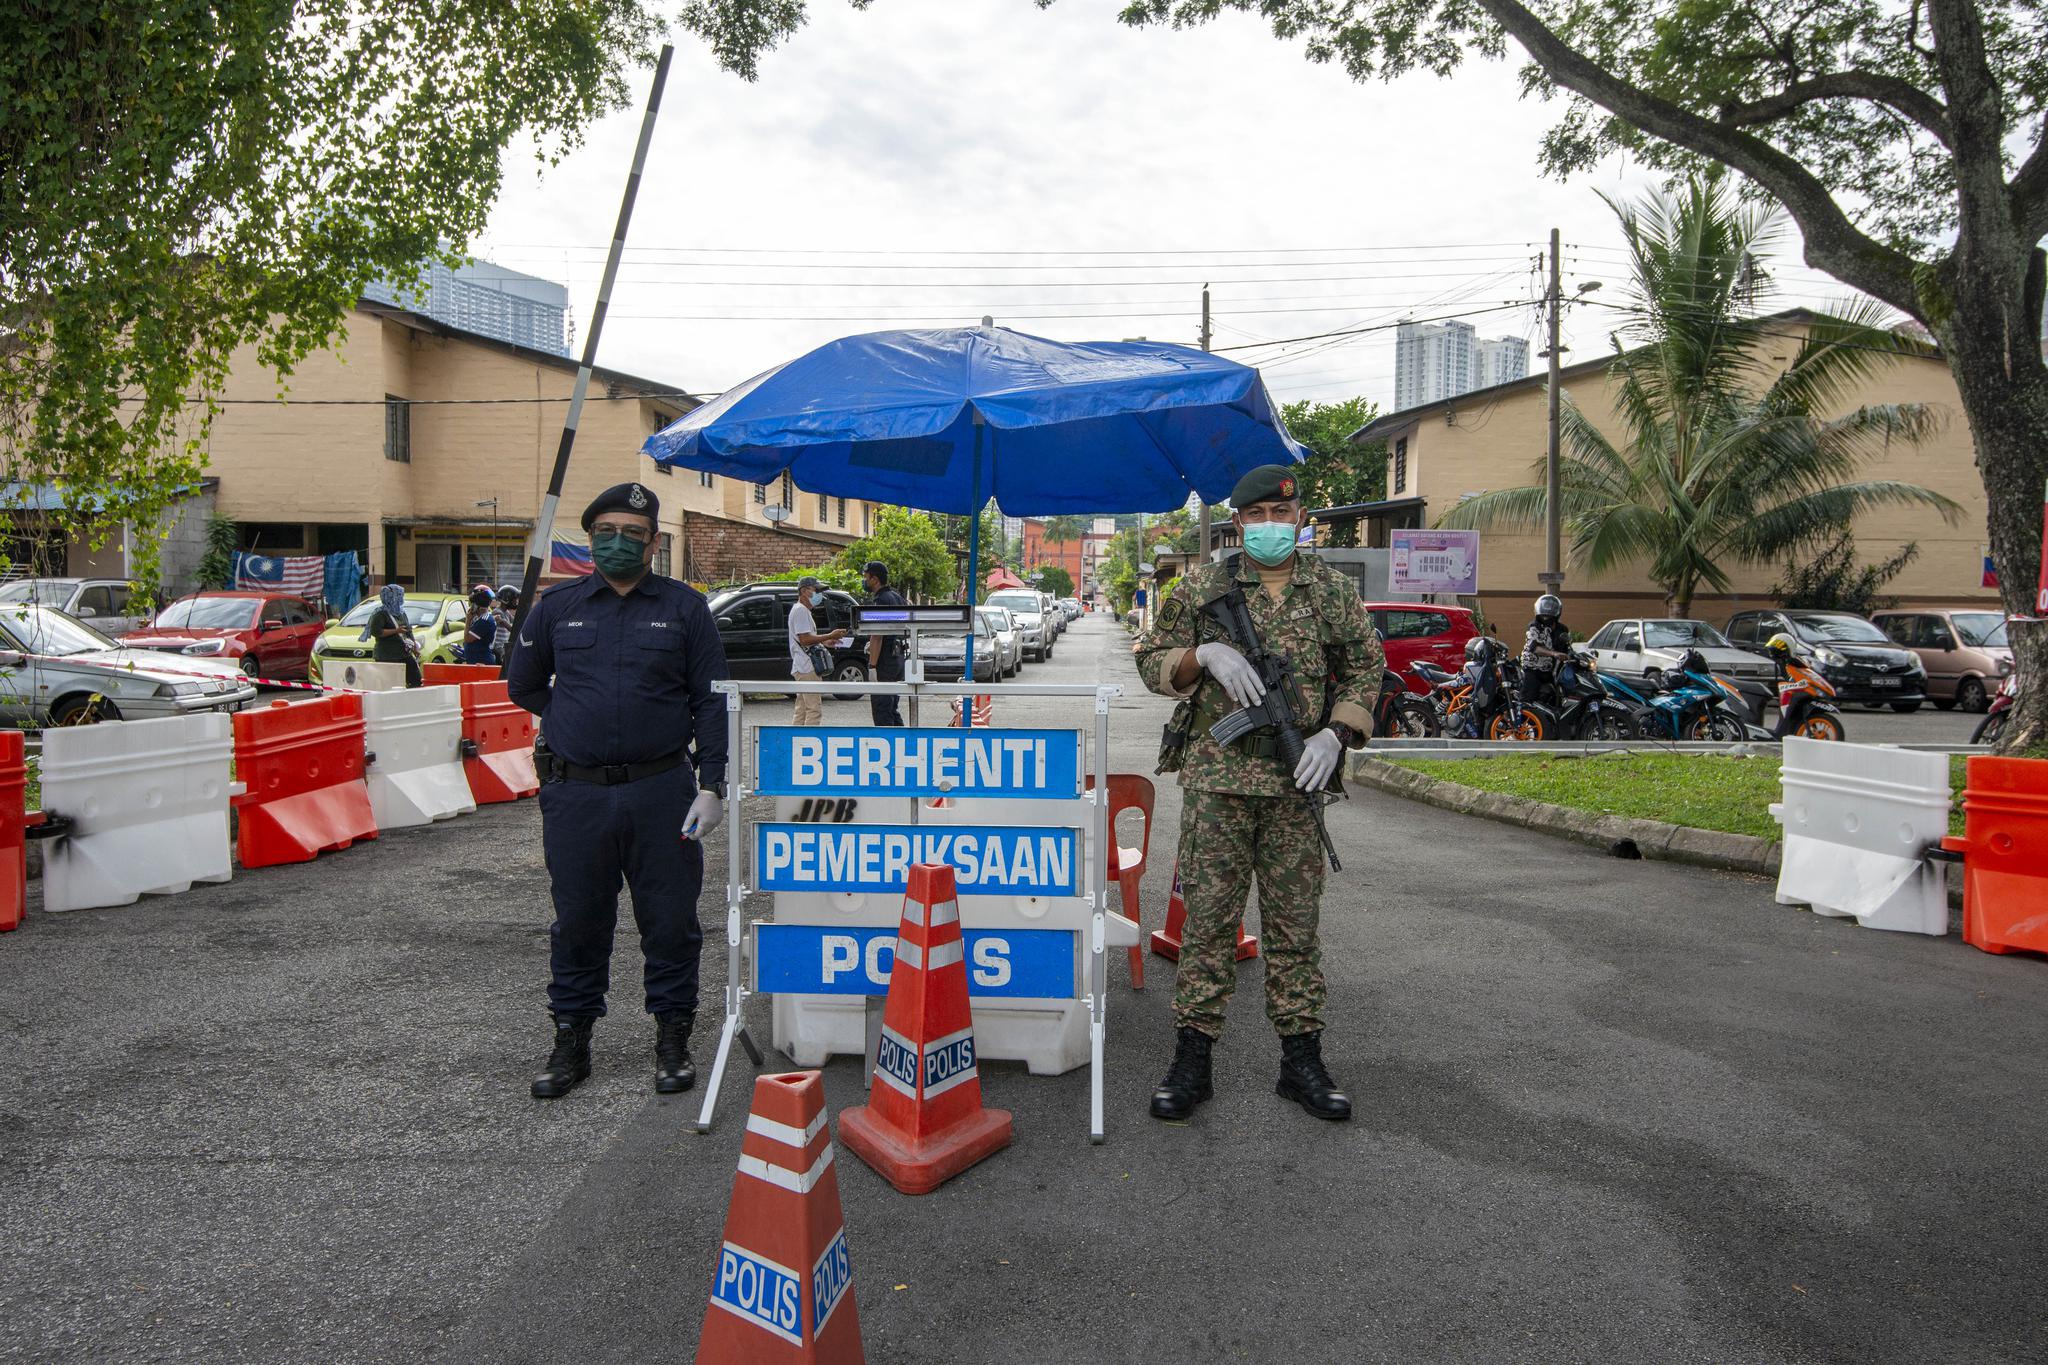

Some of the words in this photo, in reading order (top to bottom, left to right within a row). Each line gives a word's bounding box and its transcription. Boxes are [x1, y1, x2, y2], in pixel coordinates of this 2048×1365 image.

[791, 736, 1046, 788] BERHENTI
[791, 799, 857, 822] JPB
[765, 831, 1070, 887] PEMERIKSAAN
[822, 935, 1011, 987] POS
[881, 1037, 916, 1085] POLIS
[923, 1039, 972, 1085] POLIS
[719, 1250, 798, 1330] POLIS
[813, 1235, 848, 1324] POLIS
